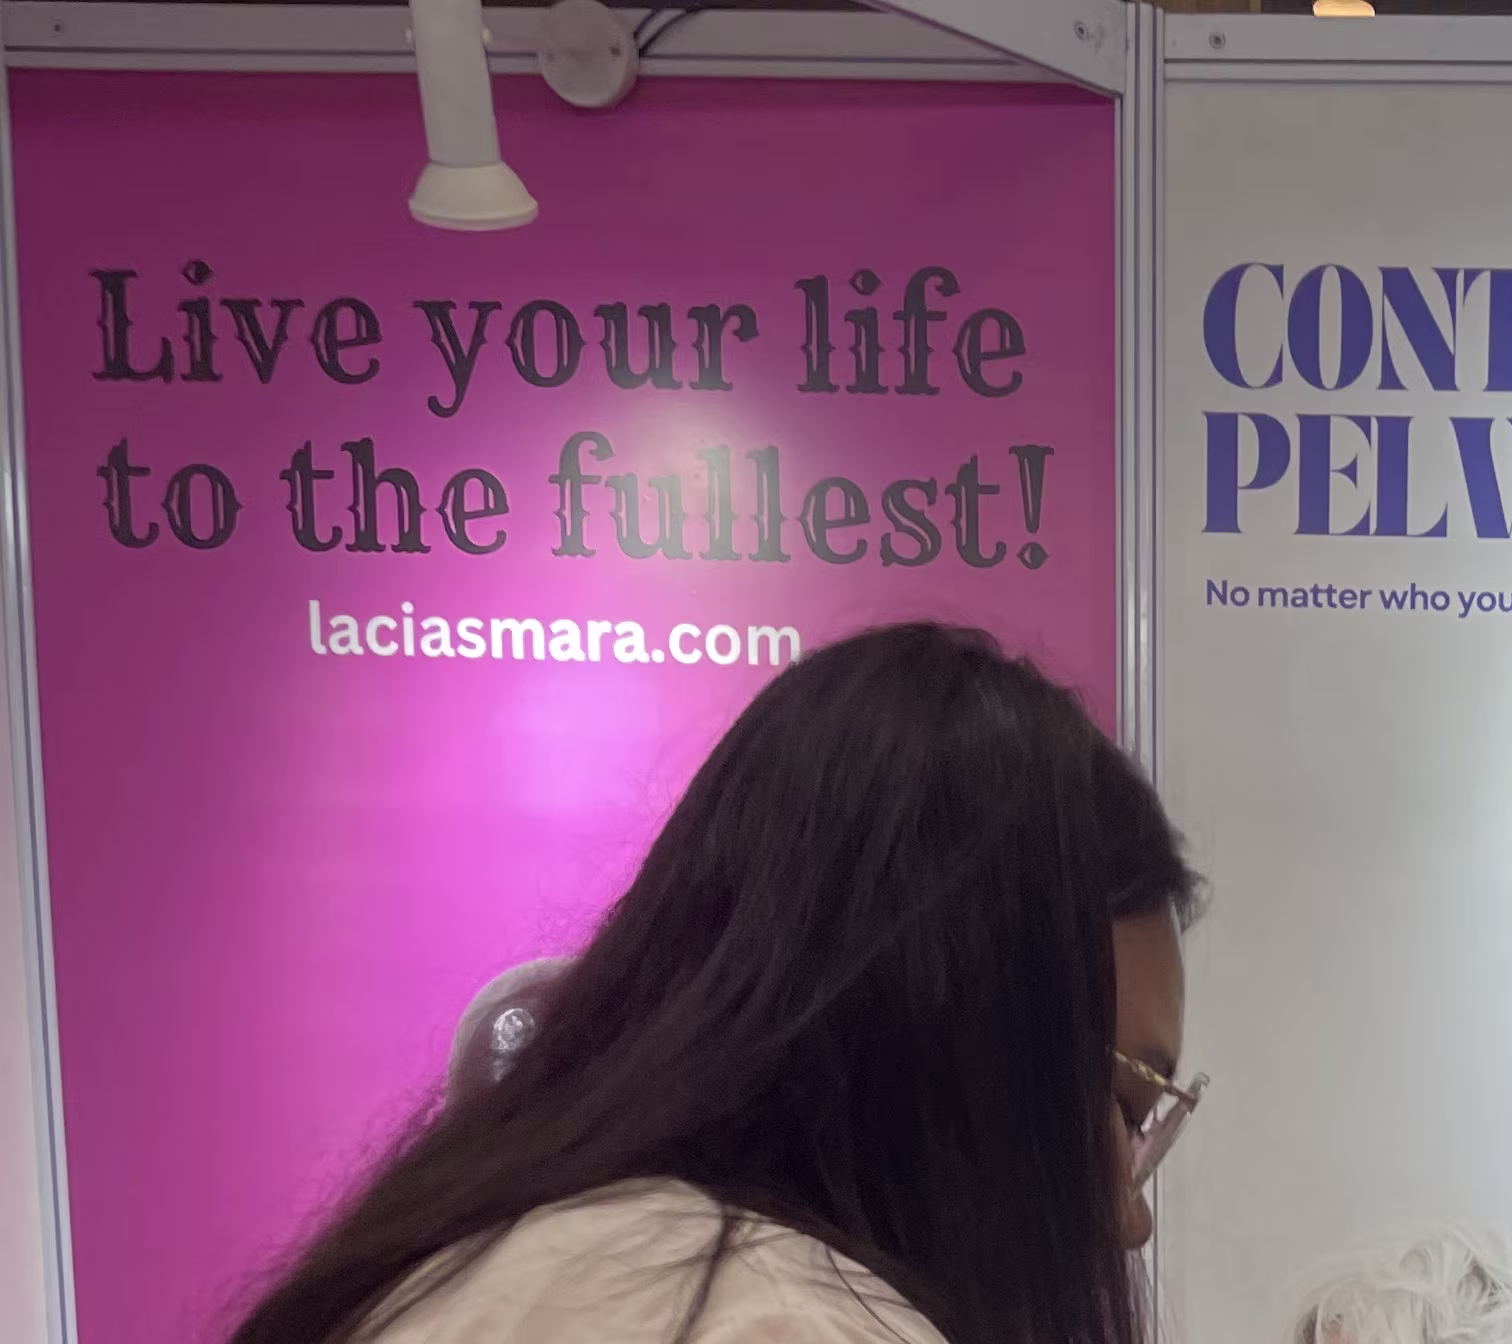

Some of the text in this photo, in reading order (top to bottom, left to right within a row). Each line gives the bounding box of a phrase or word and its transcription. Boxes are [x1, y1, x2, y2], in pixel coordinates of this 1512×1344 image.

[90, 257, 1027, 420] Live your life
[96, 430, 1056, 572] to the fullest!
[308, 599, 801, 667] laciasmara.com
[1205, 579, 1251, 608] No
[1257, 583, 1373, 611] matter
[1379, 582, 1451, 612] who
